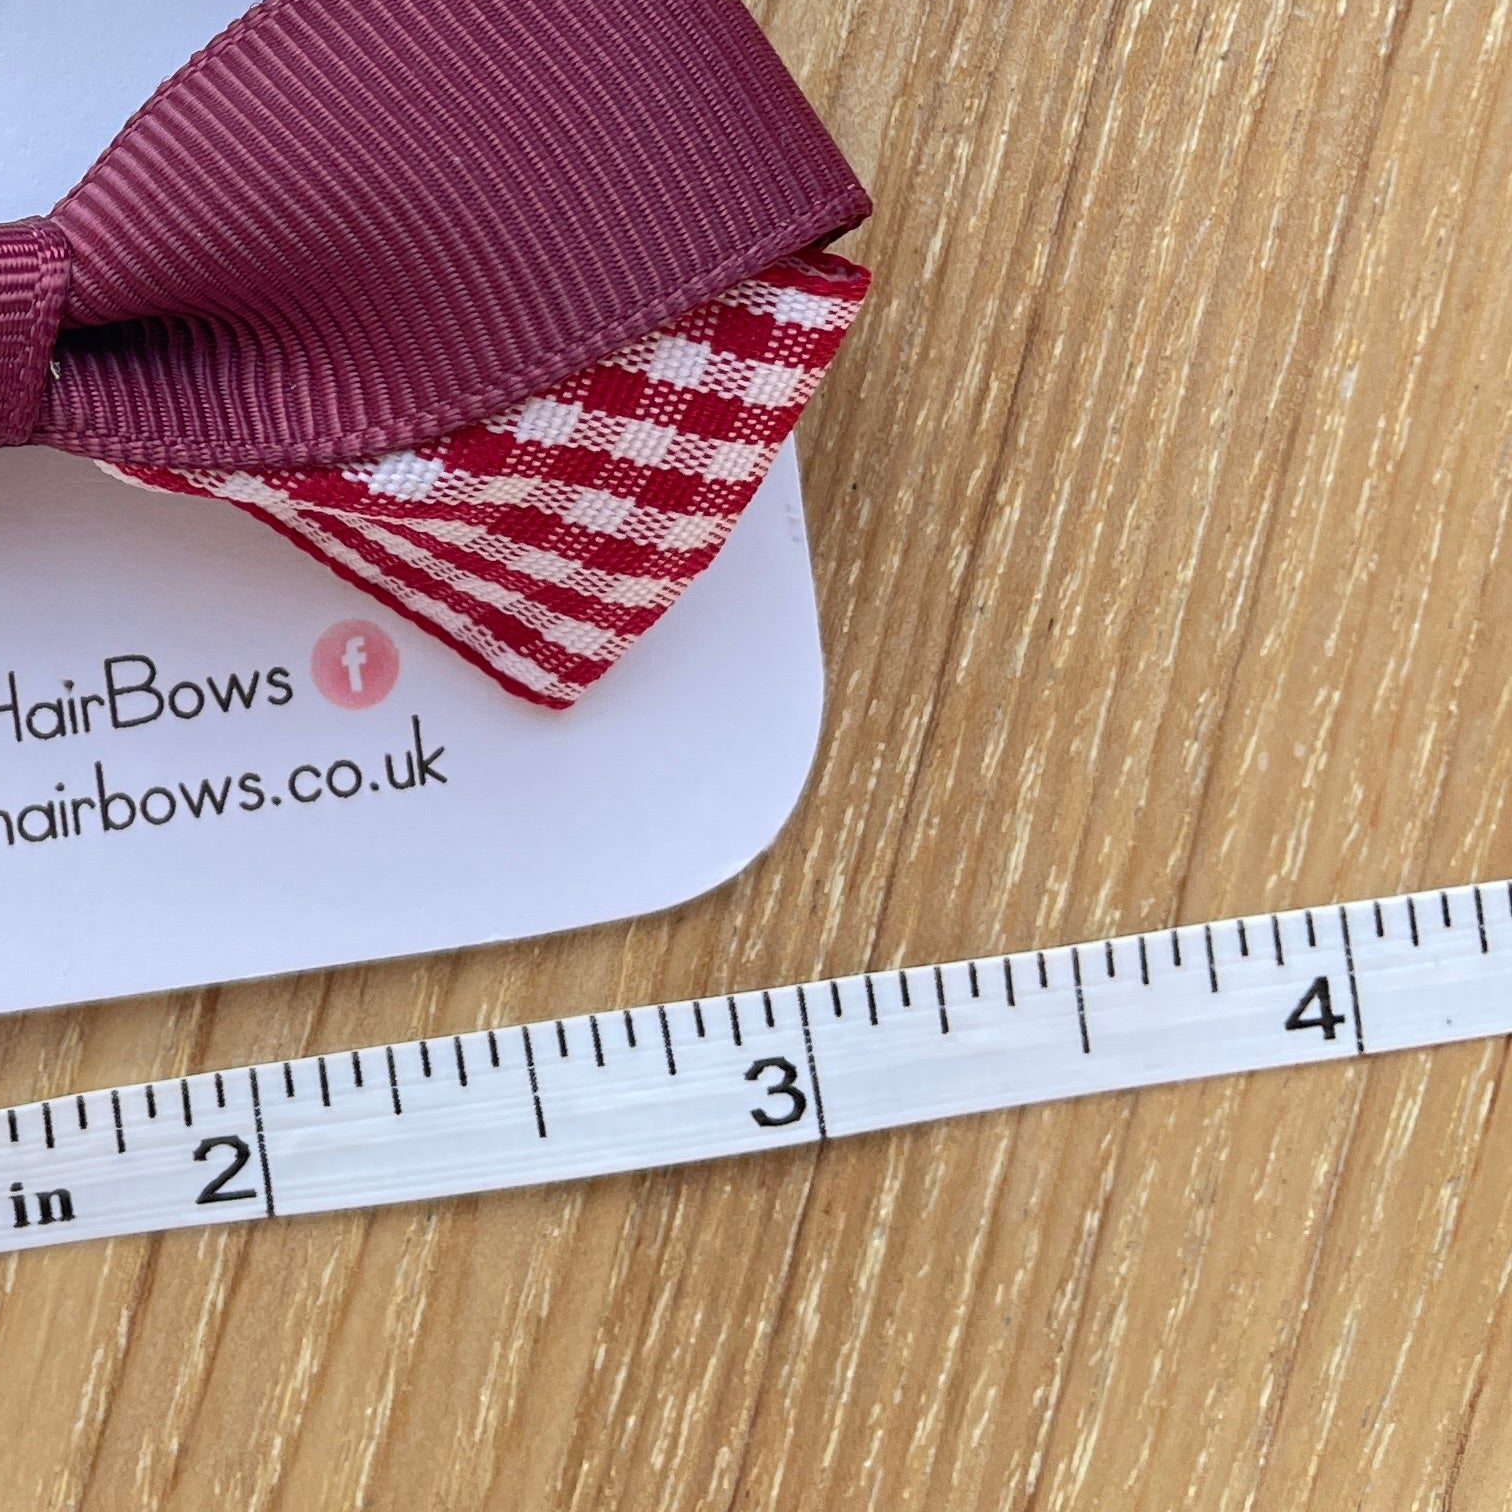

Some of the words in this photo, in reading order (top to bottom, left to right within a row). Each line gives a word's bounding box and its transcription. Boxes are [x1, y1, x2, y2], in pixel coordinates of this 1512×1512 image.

[1285, 976, 1345, 1041] 4
[745, 1056, 807, 1127] 3
[192, 1134, 257, 1205] 2
[10, 1182, 76, 1229] in
